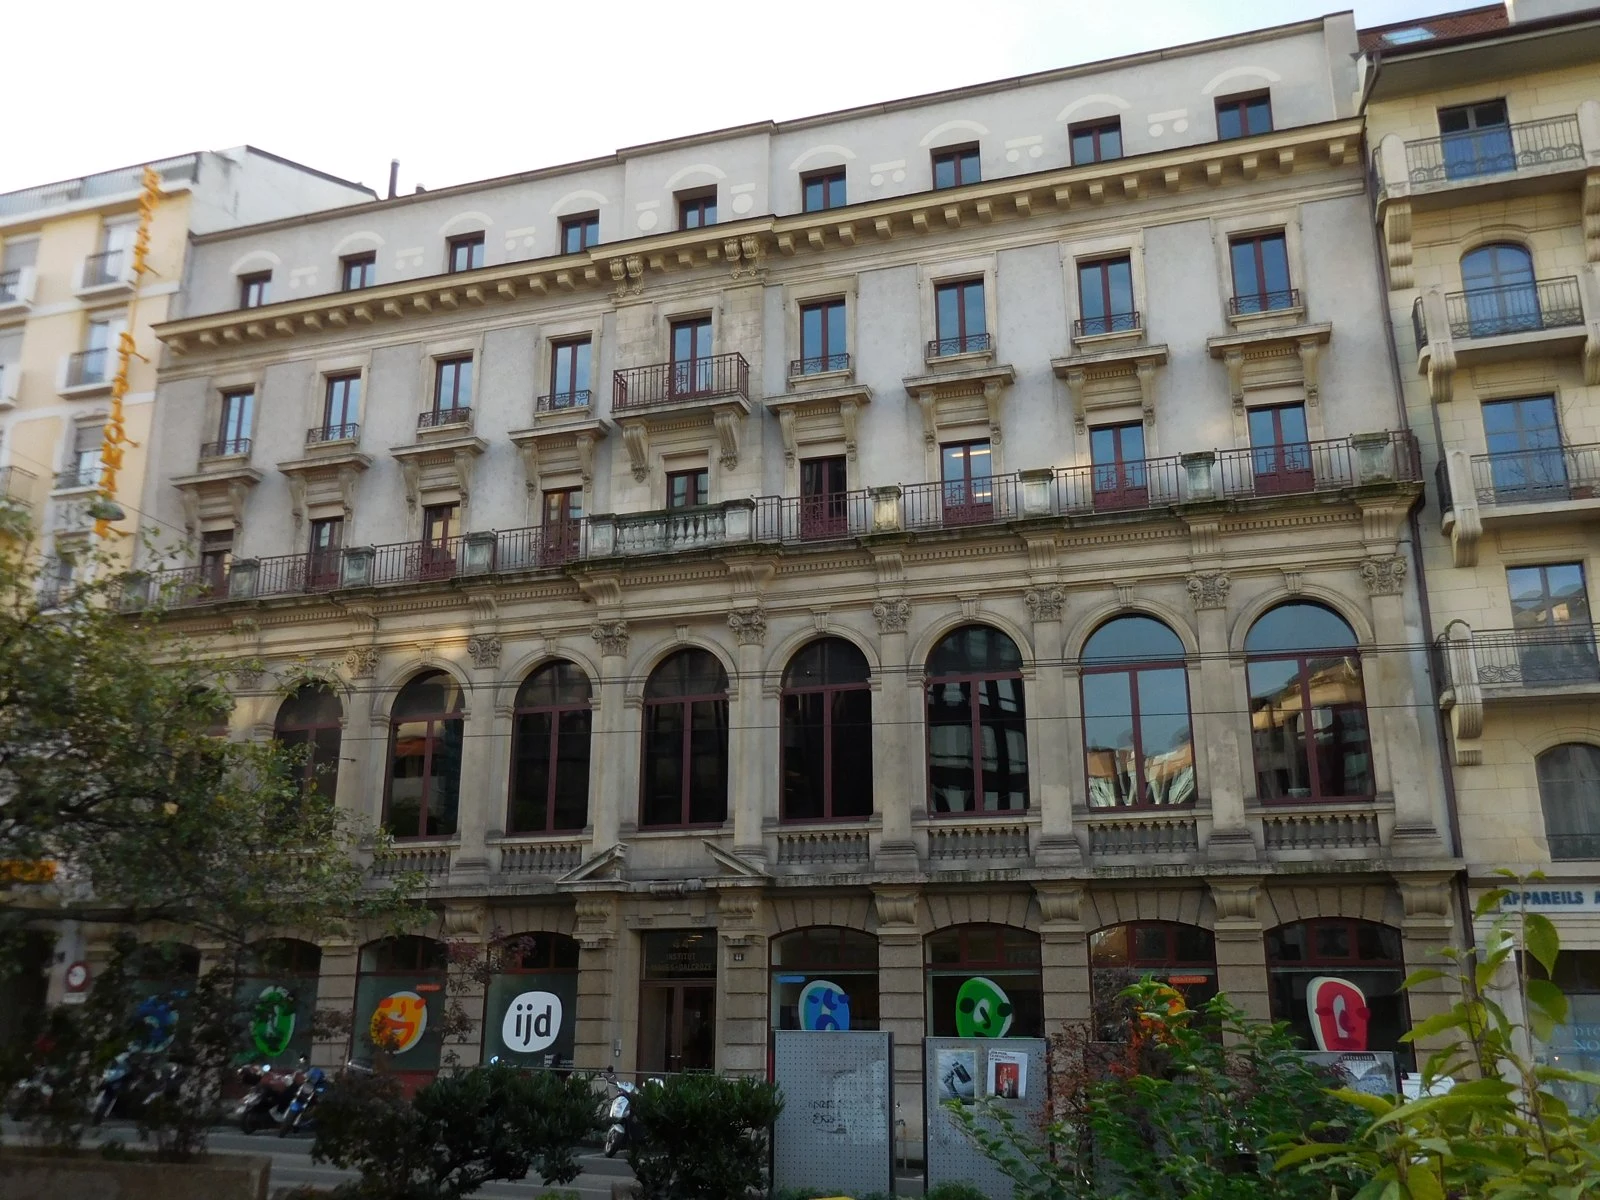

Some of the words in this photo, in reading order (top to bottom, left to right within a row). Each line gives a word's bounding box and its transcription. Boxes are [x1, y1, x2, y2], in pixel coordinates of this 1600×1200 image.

[1503, 891, 1584, 906] APPAREILS
[666, 952, 696, 961] INSTITUT
[515, 1003, 552, 1046] ijd
